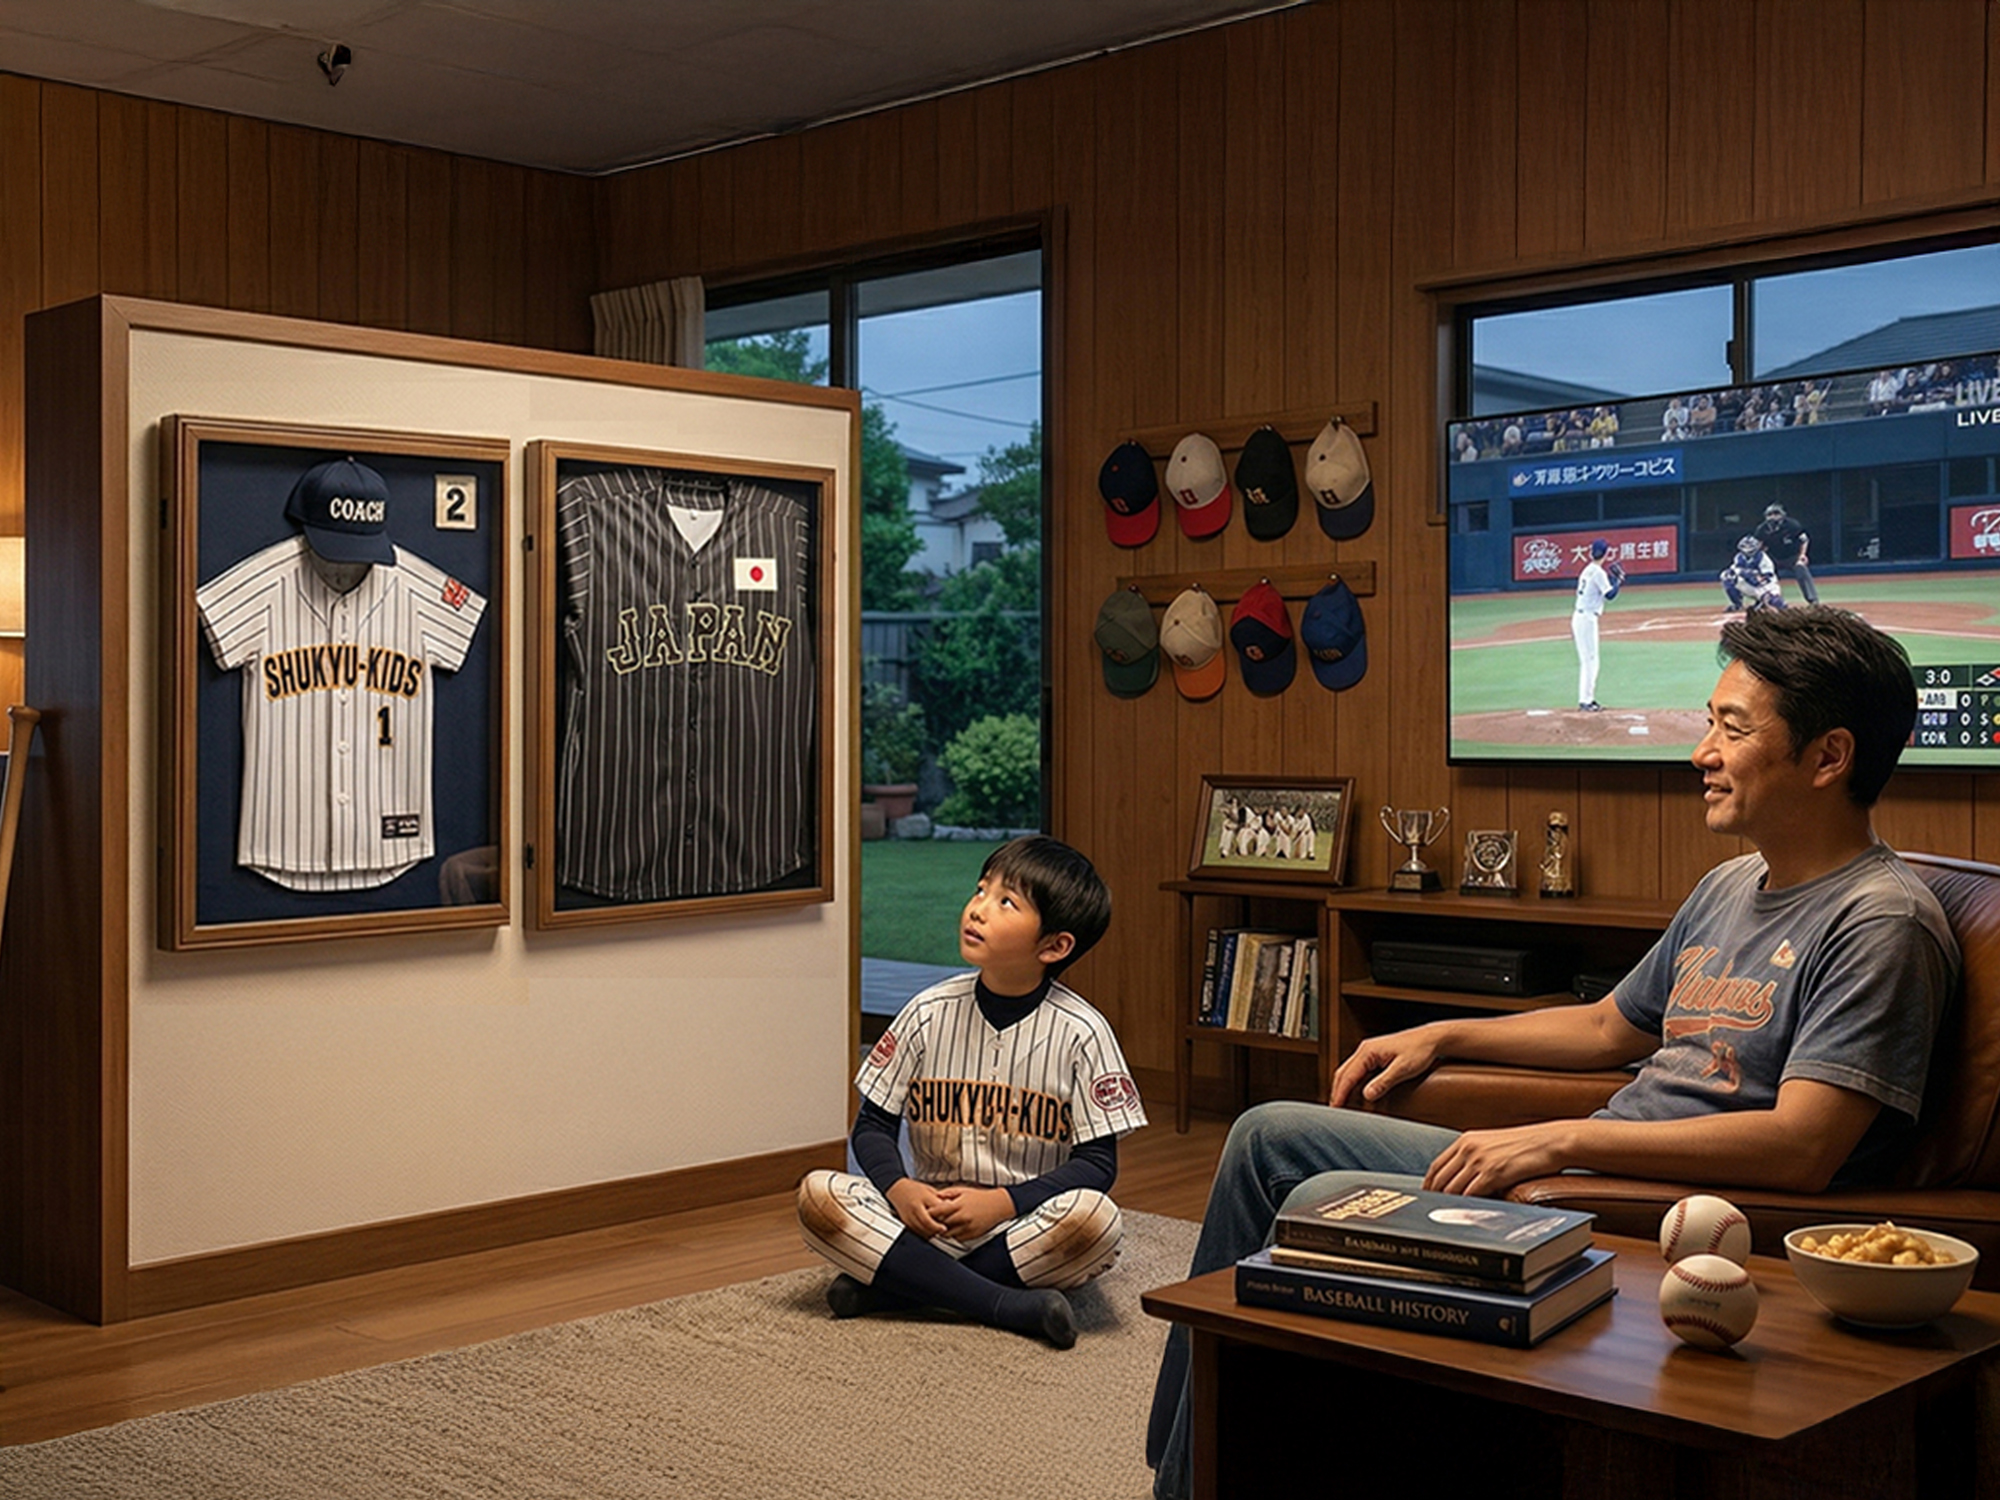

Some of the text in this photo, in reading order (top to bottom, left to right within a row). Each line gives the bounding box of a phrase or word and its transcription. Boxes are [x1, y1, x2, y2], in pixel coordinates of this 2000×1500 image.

[330, 497, 385, 522] COACH
[447, 488, 465, 521] 2
[607, 603, 792, 676] JAPAN
[263, 643, 423, 700] SHUKYU-KIDS
[377, 705, 393, 747] 1
[1303, 1286, 1385, 1313] BASEBALL
[1390, 1298, 1470, 1325] HISTORY
